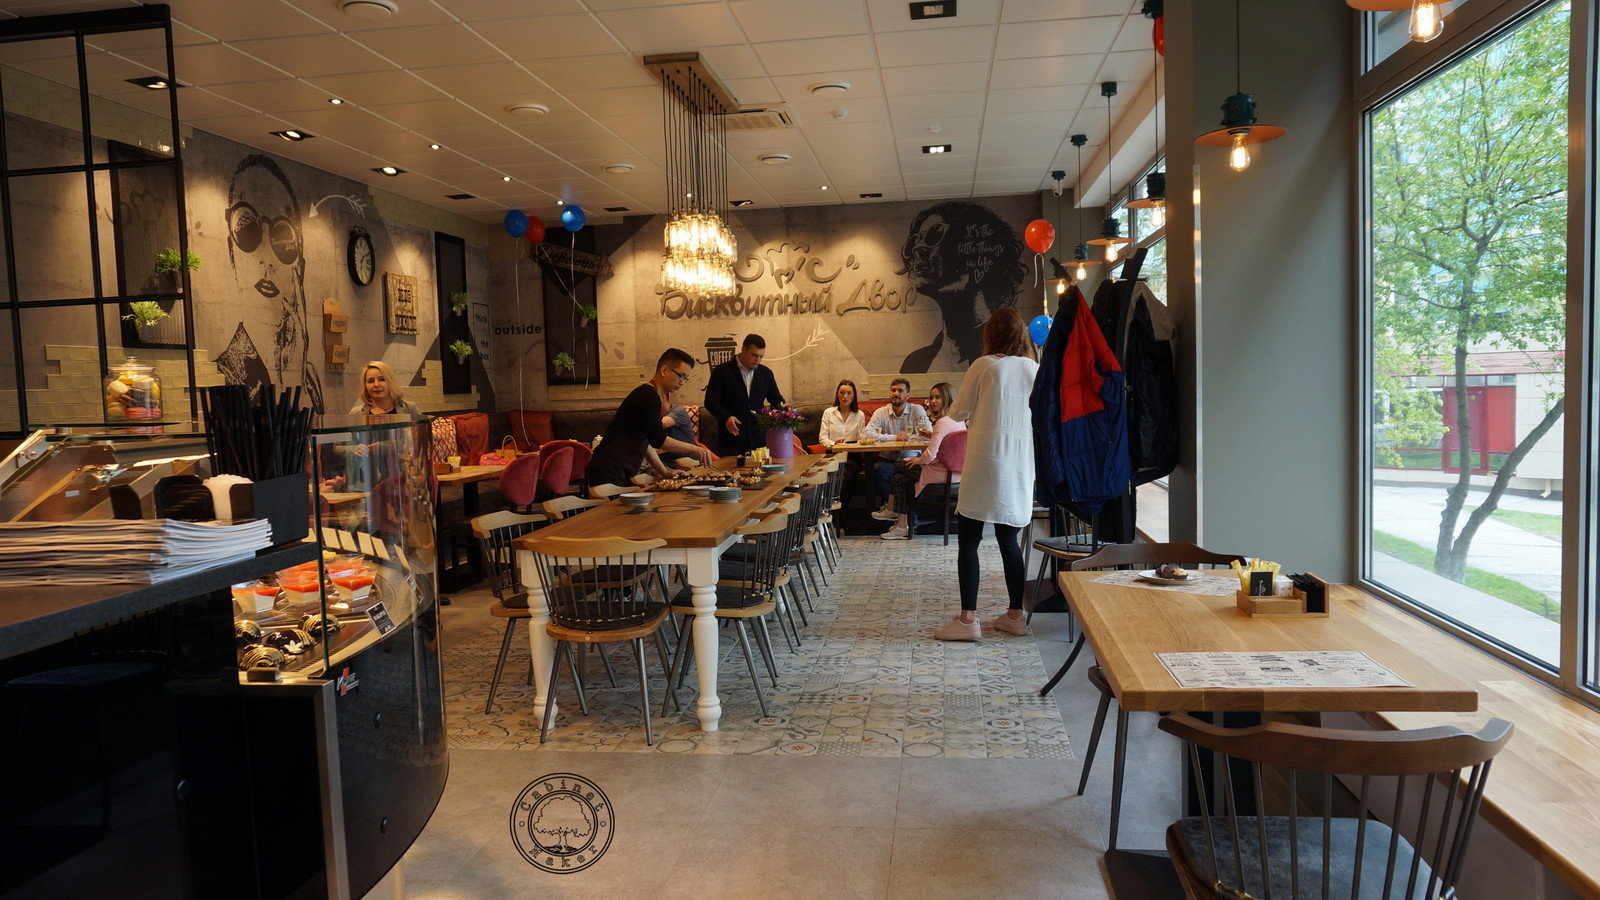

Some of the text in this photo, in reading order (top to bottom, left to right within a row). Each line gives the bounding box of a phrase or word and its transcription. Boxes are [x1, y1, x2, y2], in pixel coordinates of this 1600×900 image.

[980, 223, 994, 237] the
[957, 241, 1005, 257] little things
[977, 255, 994, 273] life
[655, 279, 917, 319] Бисквитный Двор
[494, 324, 542, 336] outside
